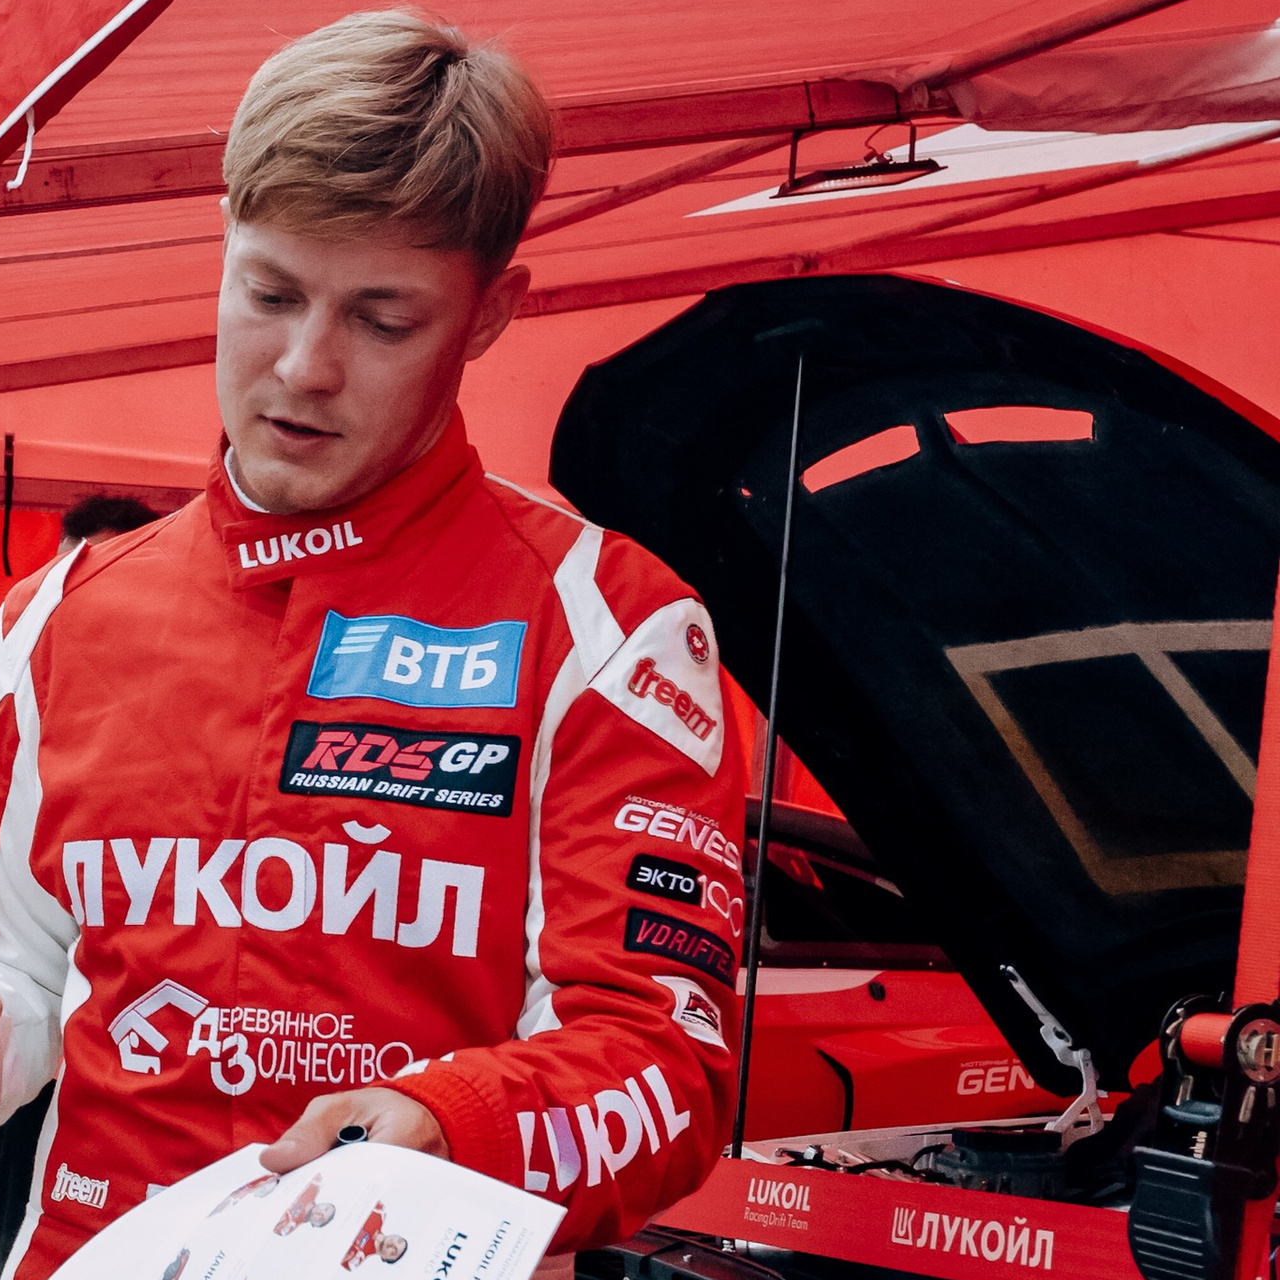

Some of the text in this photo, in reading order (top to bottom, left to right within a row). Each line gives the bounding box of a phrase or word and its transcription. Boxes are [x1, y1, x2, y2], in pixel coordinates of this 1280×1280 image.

[238, 520, 363, 569] LUKOIL
[382, 634, 500, 691] ВТБ
[627, 656, 718, 742] freem
[302, 730, 510, 782] RDS GP
[289, 772, 505, 809] RUSSIAN DRIFT SERIES
[624, 793, 687, 817] МОТОРНЫЕ
[61, 820, 486, 958] ЛУКОЙЛ
[636, 865, 696, 894] ЭКТО
[635, 918, 734, 974] VDRIFTE
[50, 1162, 110, 1210] freem
[747, 1177, 811, 1212] LUKOIL
[477, 1220, 510, 1270] LUKOIL
[786, 1213, 808, 1231] Team
[916, 1212, 1055, 1270] ЛУКОЙЛ
